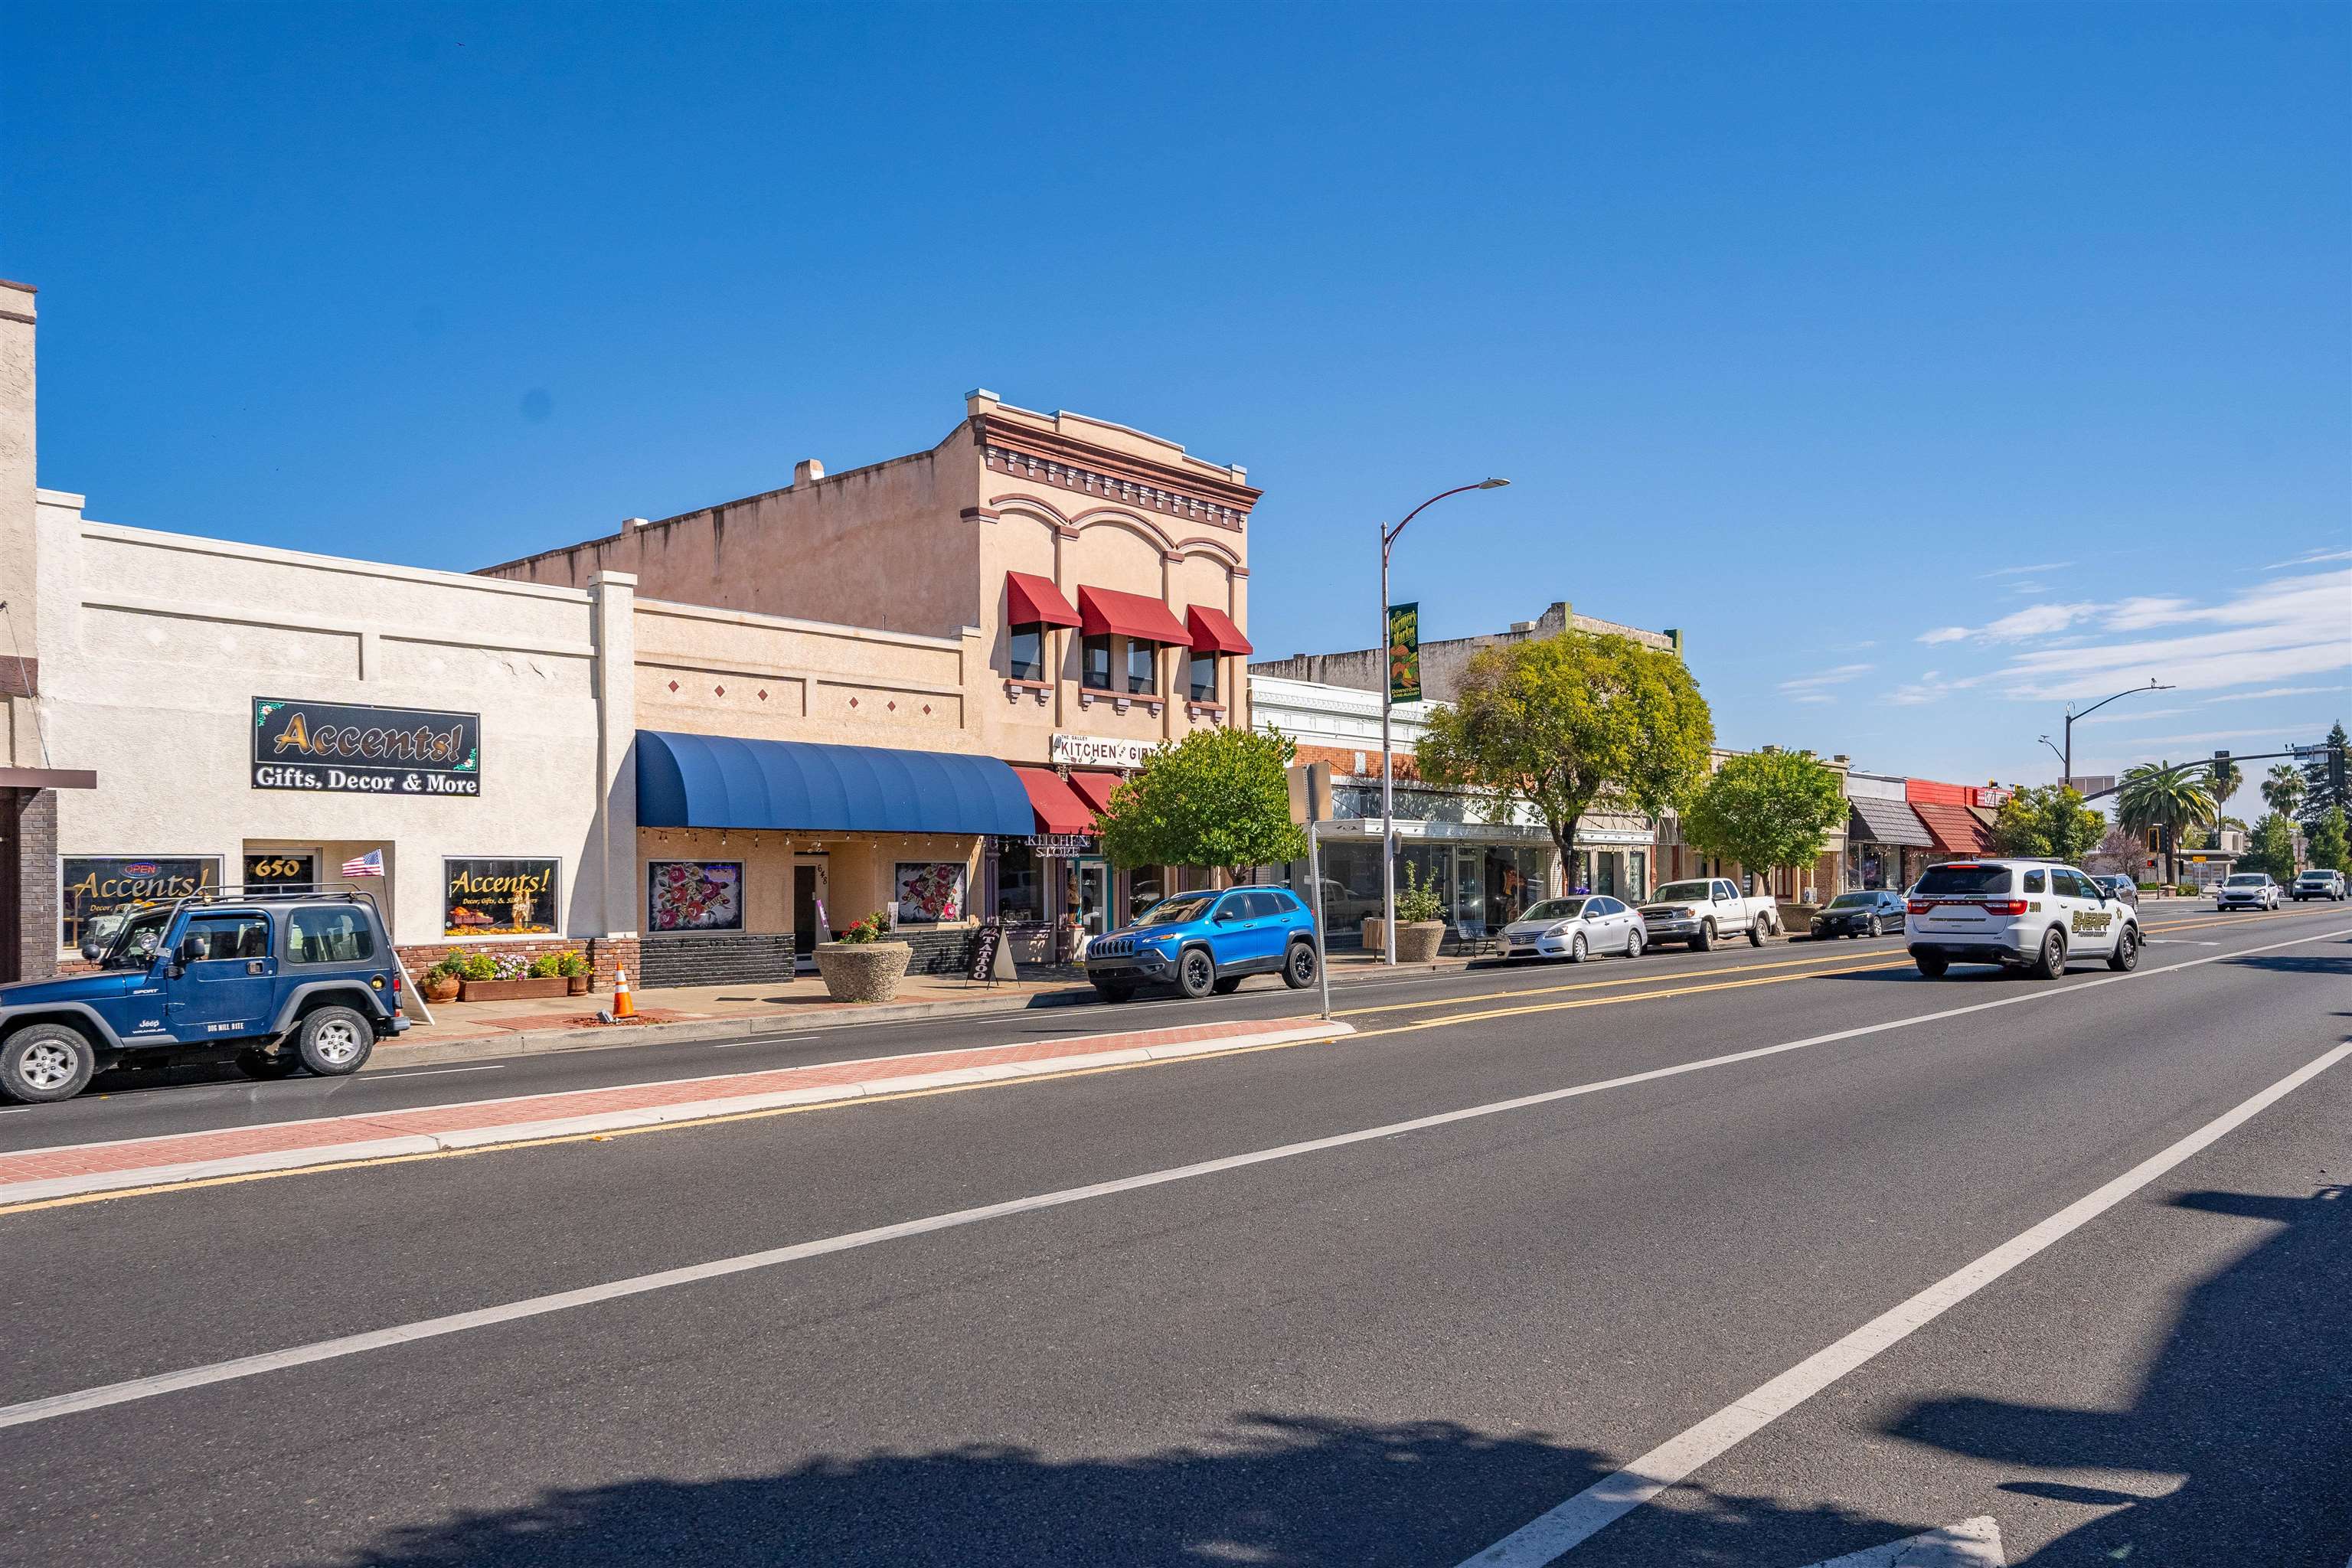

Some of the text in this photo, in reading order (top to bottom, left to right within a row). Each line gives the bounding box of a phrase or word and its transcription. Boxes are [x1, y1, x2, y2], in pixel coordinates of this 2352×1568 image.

[273, 711, 463, 763] Accents!
[1061, 741, 1116, 759] KITCHEN
[256, 766, 478, 792] Gifts, Decor & More
[1025, 834, 1092, 847] KITCHEN
[1035, 846, 1080, 858] STORE
[124, 864, 156, 874] OPEN
[255, 859, 300, 877] 650
[817, 864, 828, 885] 648
[74, 868, 209, 899] Accents!
[450, 868, 550, 894] Accents!
[2029, 902, 2042, 913] 911
[2072, 910, 2112, 933] SHERIFF
[973, 936, 995, 979] TATTOO
[139, 1019, 160, 1027] Jeep
